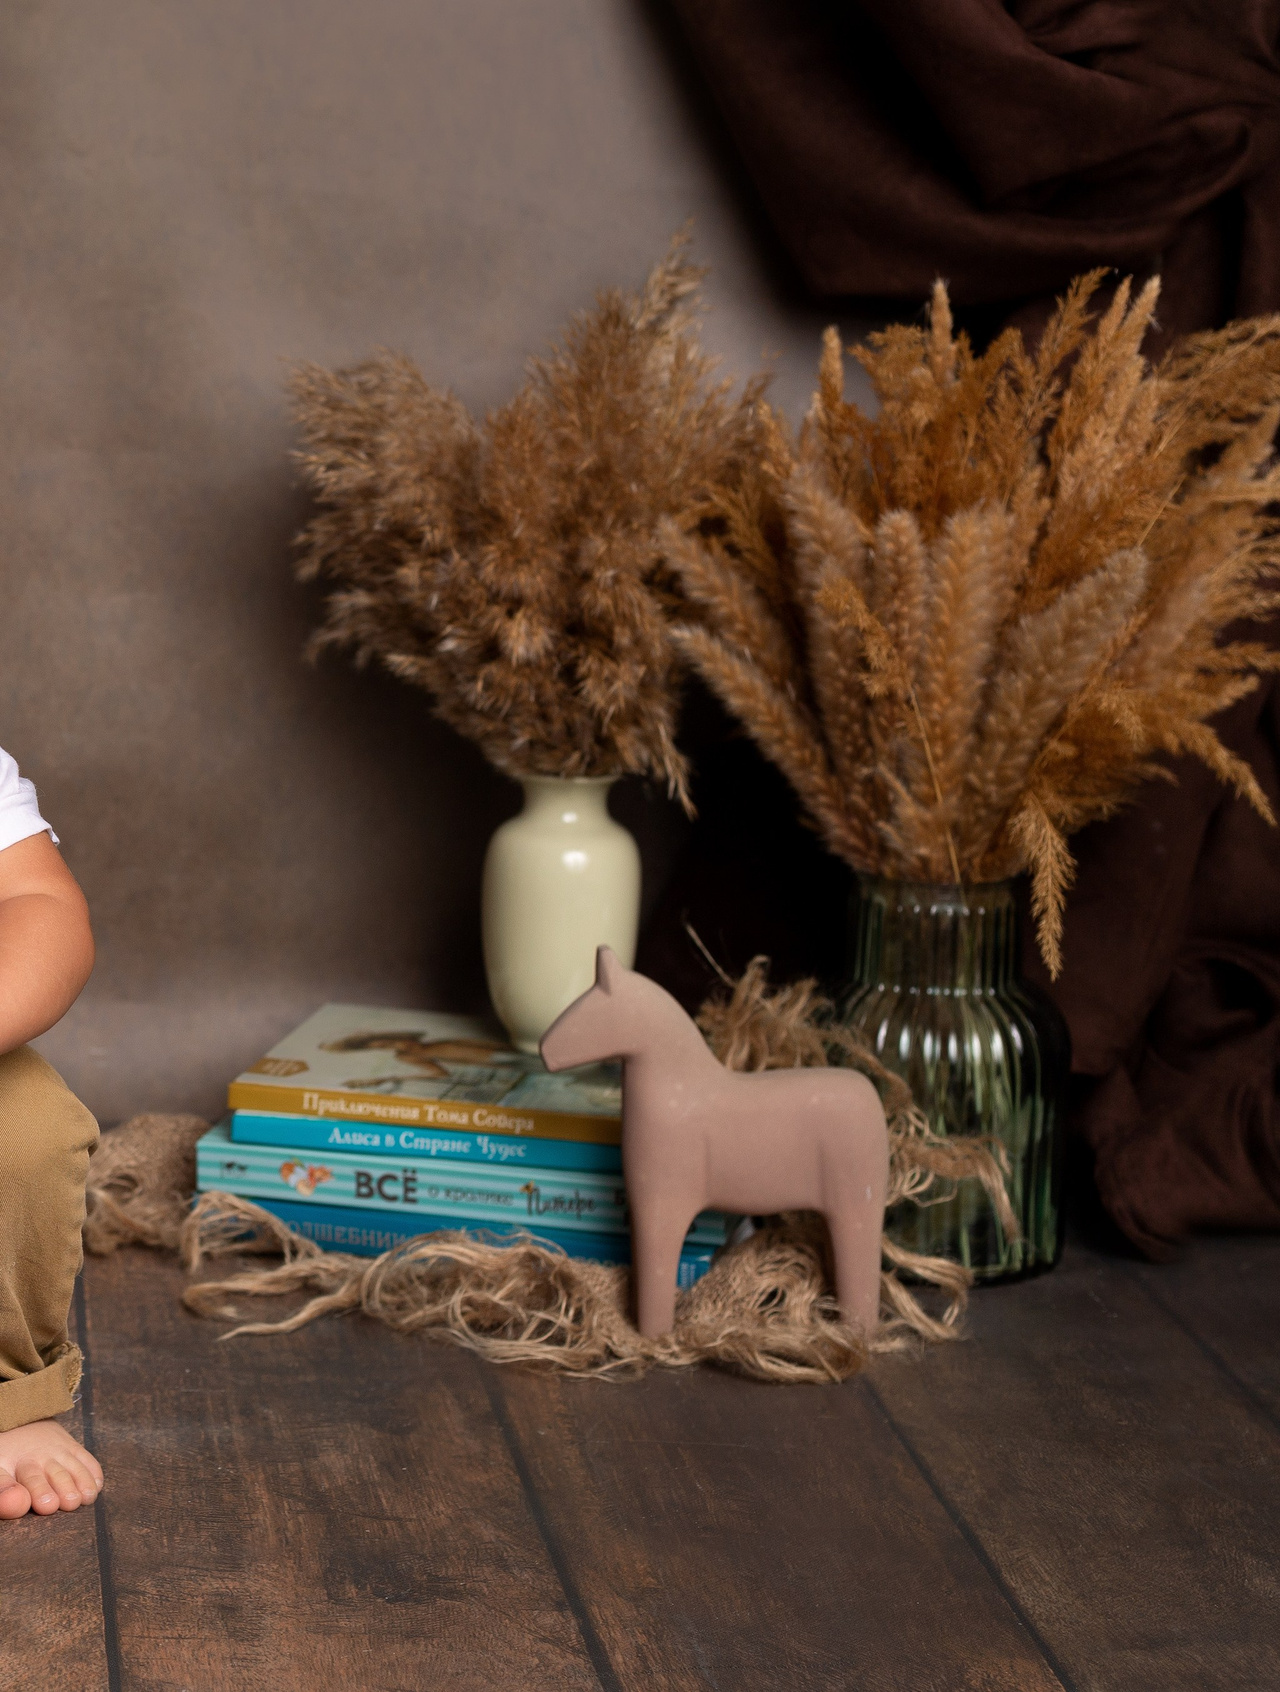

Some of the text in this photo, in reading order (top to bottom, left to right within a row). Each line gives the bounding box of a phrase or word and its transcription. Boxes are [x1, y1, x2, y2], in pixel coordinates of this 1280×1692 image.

[303, 1091, 535, 1135] Приключения Тома Сойера
[328, 1127, 527, 1161] Алиса в Стране Чудес
[355, 1168, 419, 1204] ВСЁ
